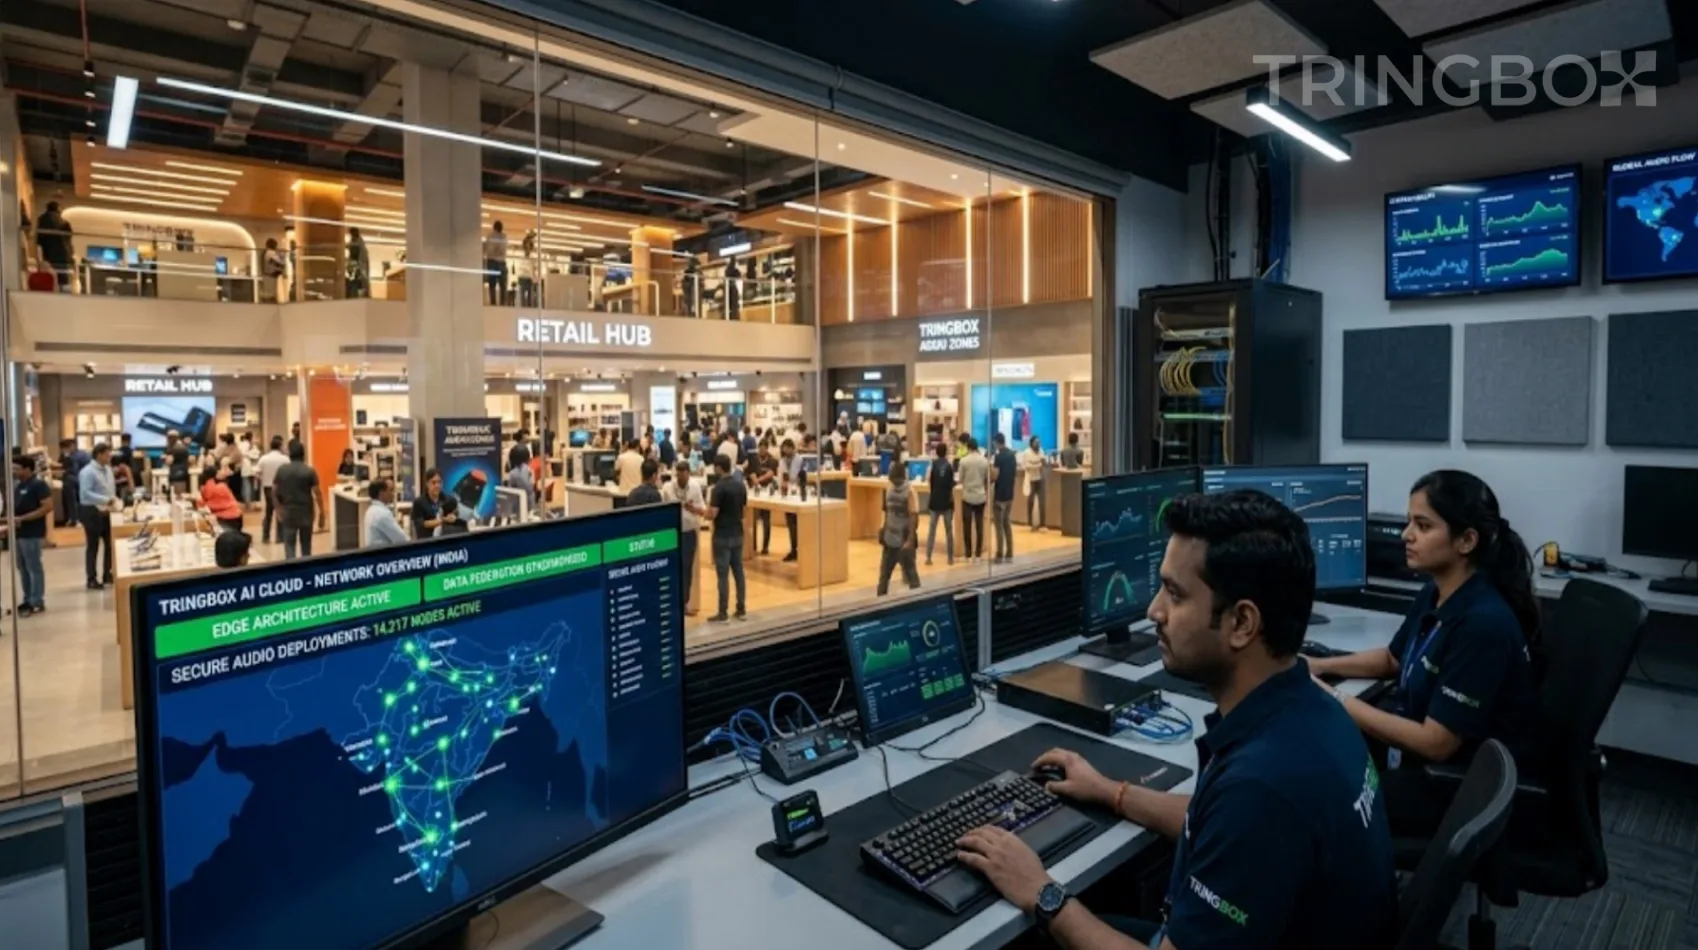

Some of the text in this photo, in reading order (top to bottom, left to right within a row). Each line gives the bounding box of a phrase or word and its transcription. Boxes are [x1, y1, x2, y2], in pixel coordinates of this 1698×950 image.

[517, 318, 652, 346] RETAIL HUB
[918, 319, 980, 337] TRINGBOX
[125, 379, 213, 392] RETAIL HUB
[159, 588, 237, 616] TRINGBOX
[240, 585, 255, 600] AI
[259, 577, 304, 598] CLOUD
[314, 564, 374, 588] NETWORK
[376, 555, 432, 576] OVERVIEW
[433, 548, 469, 569] (INDIA)
[443, 574, 469, 591] DATA
[212, 590, 391, 639] EDGE ARCHITECTURE ACTIVE
[171, 657, 230, 684] SECURE
[232, 646, 275, 670] AUDIO
[278, 626, 371, 659] DEPLOYMENTS:
[411, 608, 445, 627] NODES
[447, 600, 482, 619] ACTIVE
[1190, 875, 1249, 927] TRINGBOX
